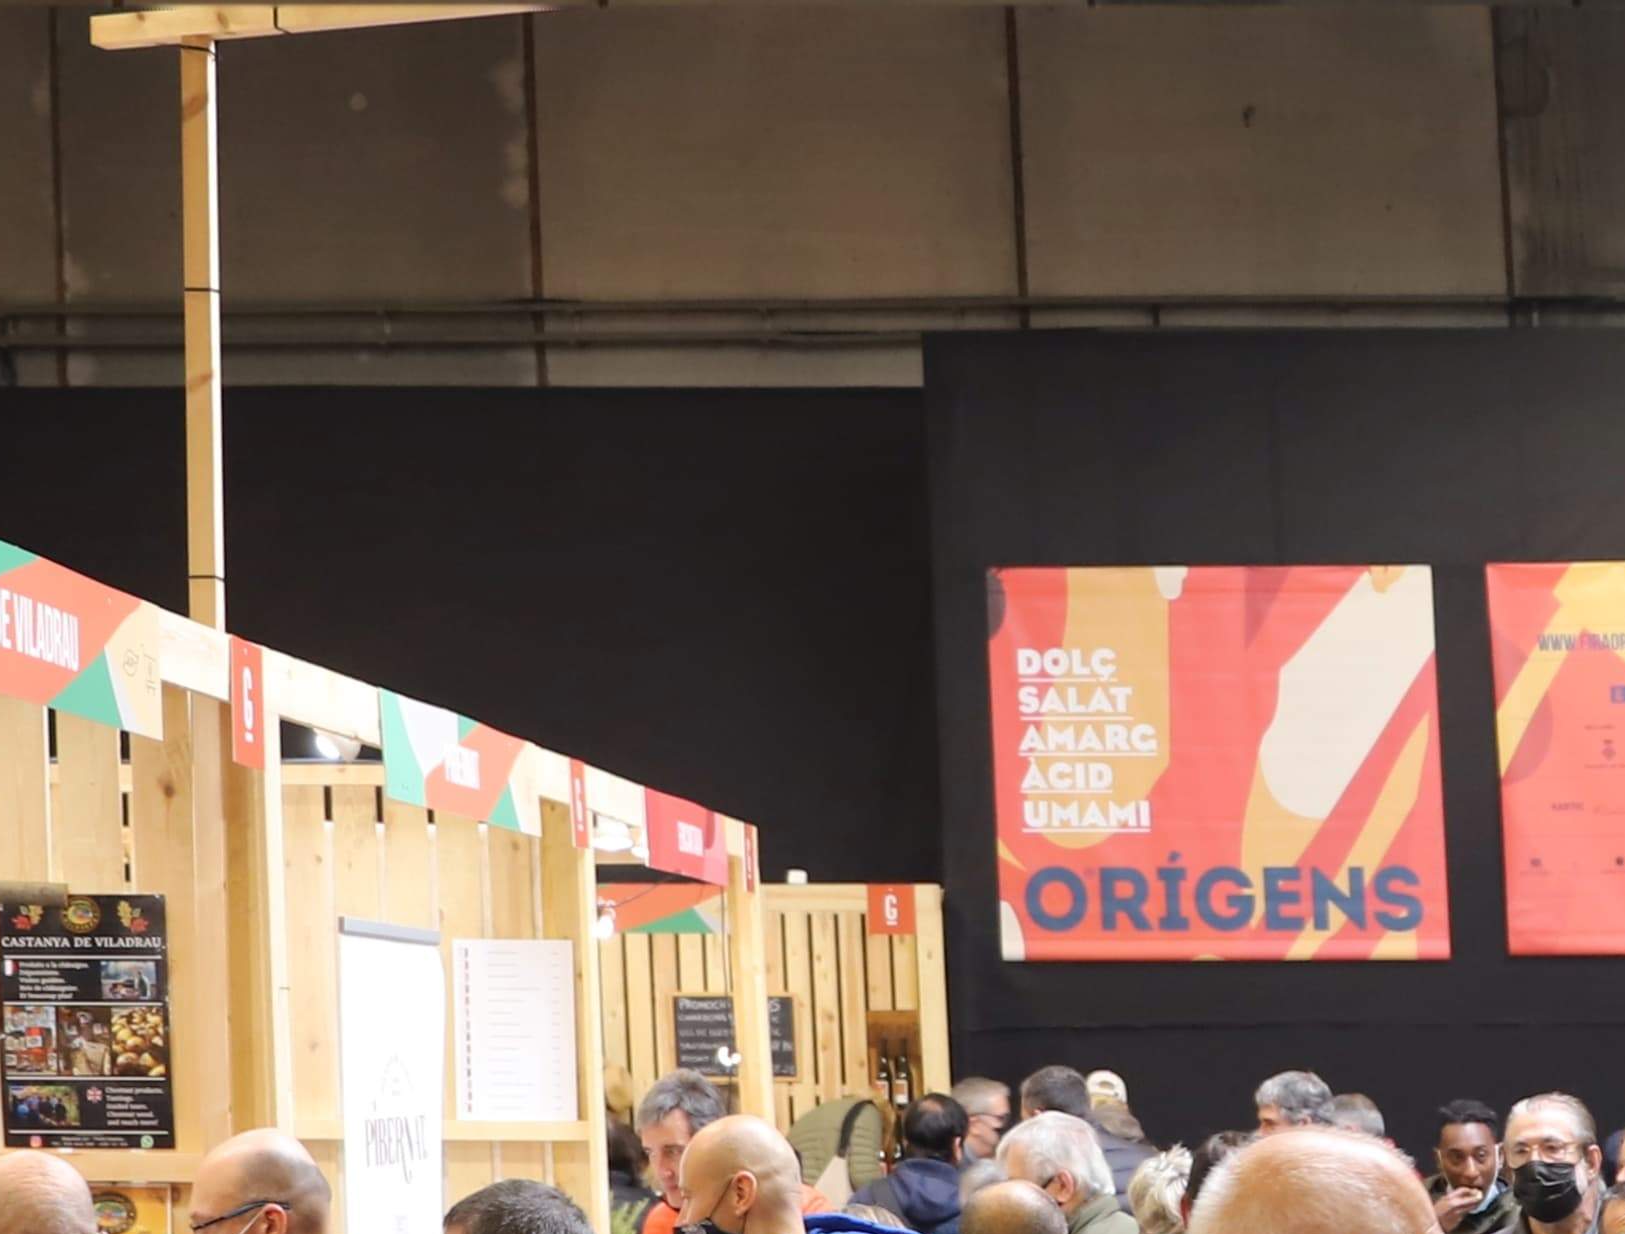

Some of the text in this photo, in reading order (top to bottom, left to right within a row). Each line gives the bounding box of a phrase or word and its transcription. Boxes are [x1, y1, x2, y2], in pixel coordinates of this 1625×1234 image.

[13, 592, 79, 673] VILADRAU
[1016, 647, 1117, 683] DOLÇ
[1017, 686, 1134, 714] SALAT
[1018, 724, 1159, 752] AMARG
[1020, 756, 1114, 790] ÀCID
[1023, 799, 1152, 829] UMAMI
[1024, 851, 1424, 932] ORÍGENS
[1, 935, 162, 949] CASTANYA DE VILADRAU
